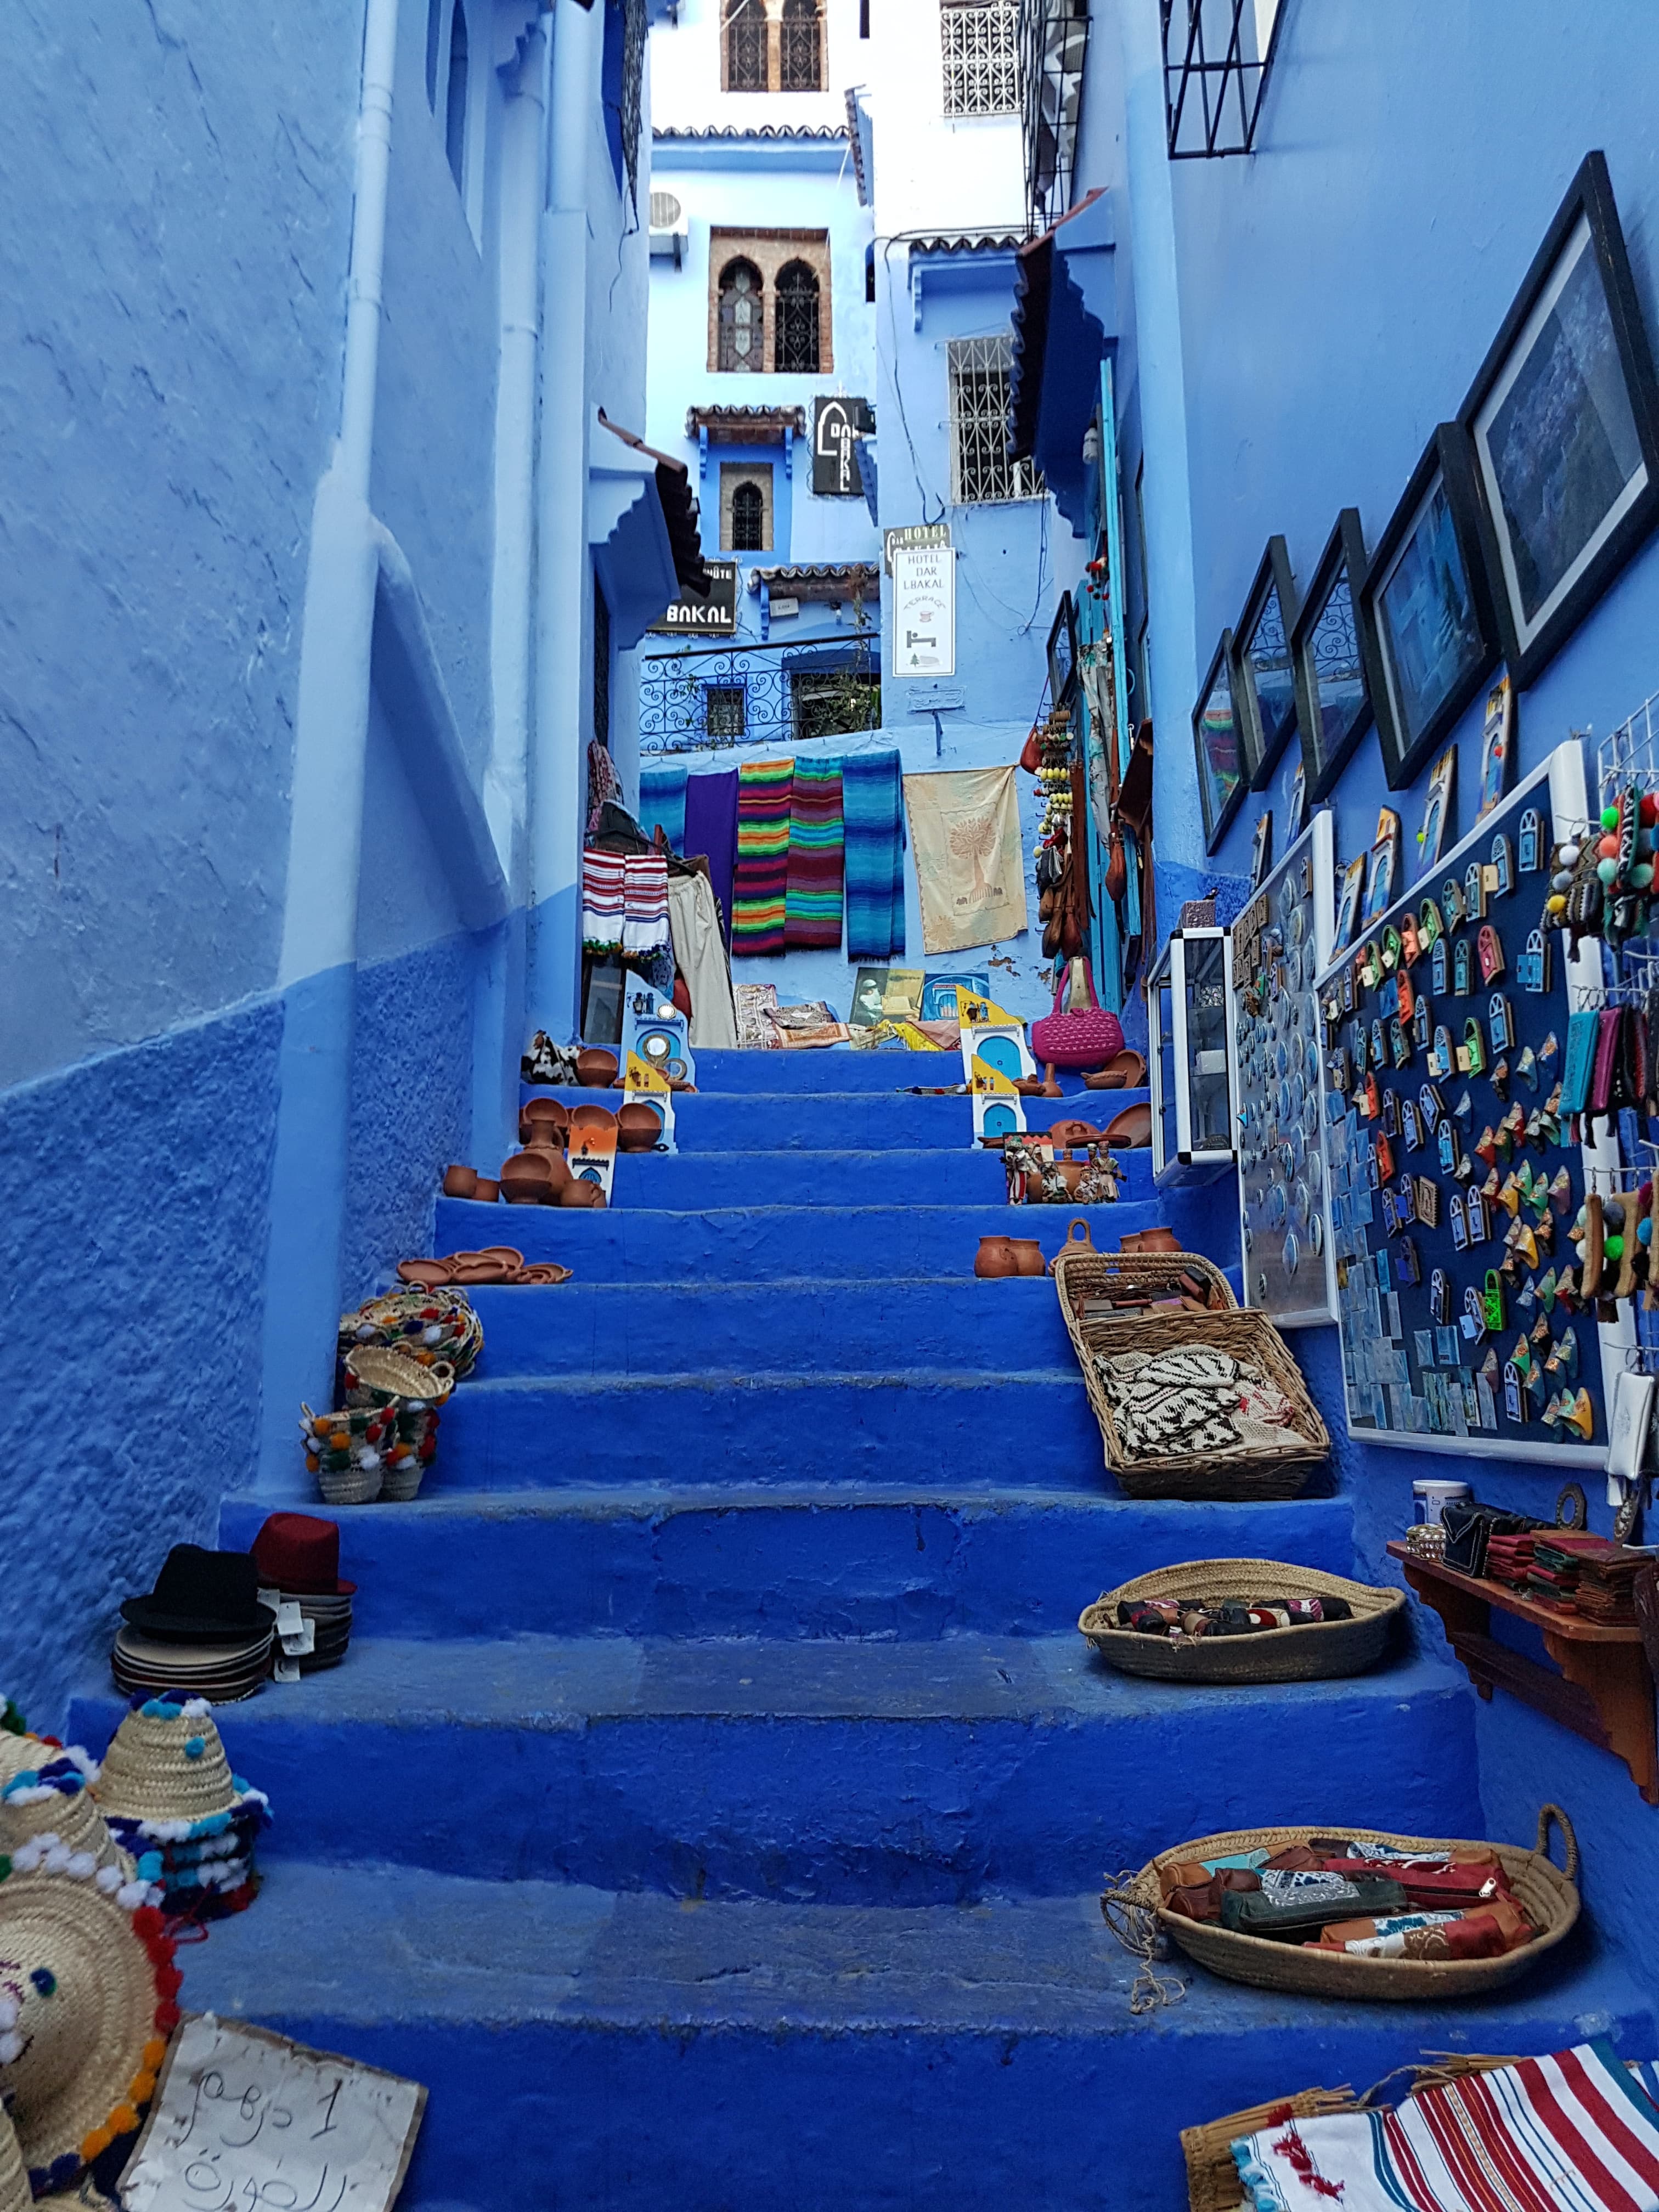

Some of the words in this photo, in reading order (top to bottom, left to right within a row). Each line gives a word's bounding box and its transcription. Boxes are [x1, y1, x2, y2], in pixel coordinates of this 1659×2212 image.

[904, 524, 946, 540] HOTEL
[908, 554, 941, 565] HOTEL
[917, 567, 937, 577] DAR
[904, 596, 946, 610] TERRACE
[667, 605, 731, 623] BAKAL
[175, 2072, 292, 2147] درهم
